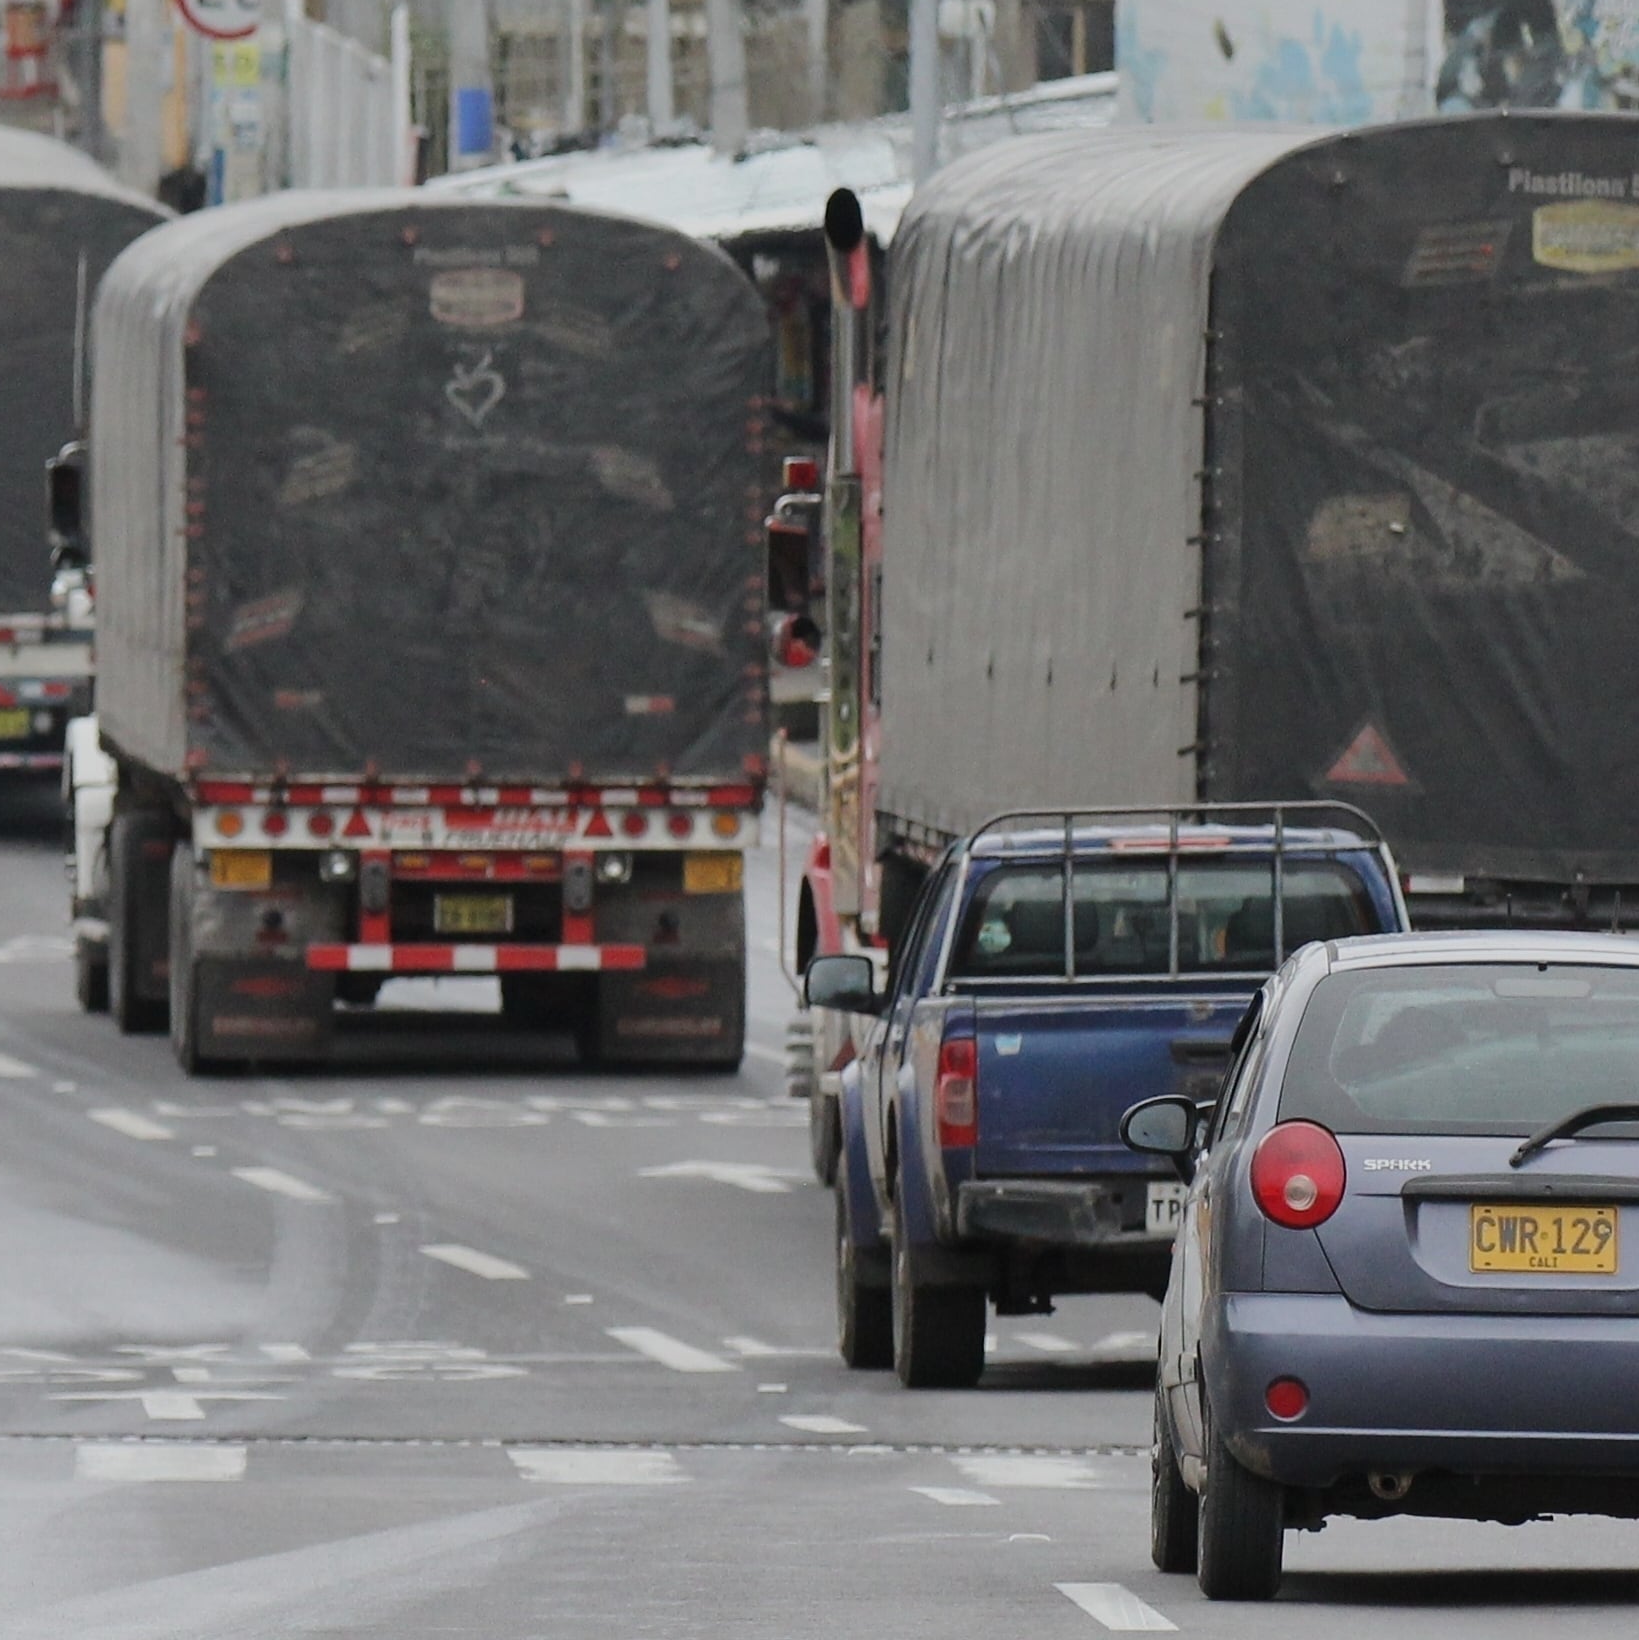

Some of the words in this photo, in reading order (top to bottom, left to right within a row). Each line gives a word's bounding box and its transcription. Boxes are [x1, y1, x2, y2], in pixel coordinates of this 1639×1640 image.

[1363, 1158, 1432, 1172] SPARK
[1474, 1214, 1540, 1256] CWR
[1549, 1216, 1614, 1257] 129
[1528, 1256, 1559, 1270] CALI
